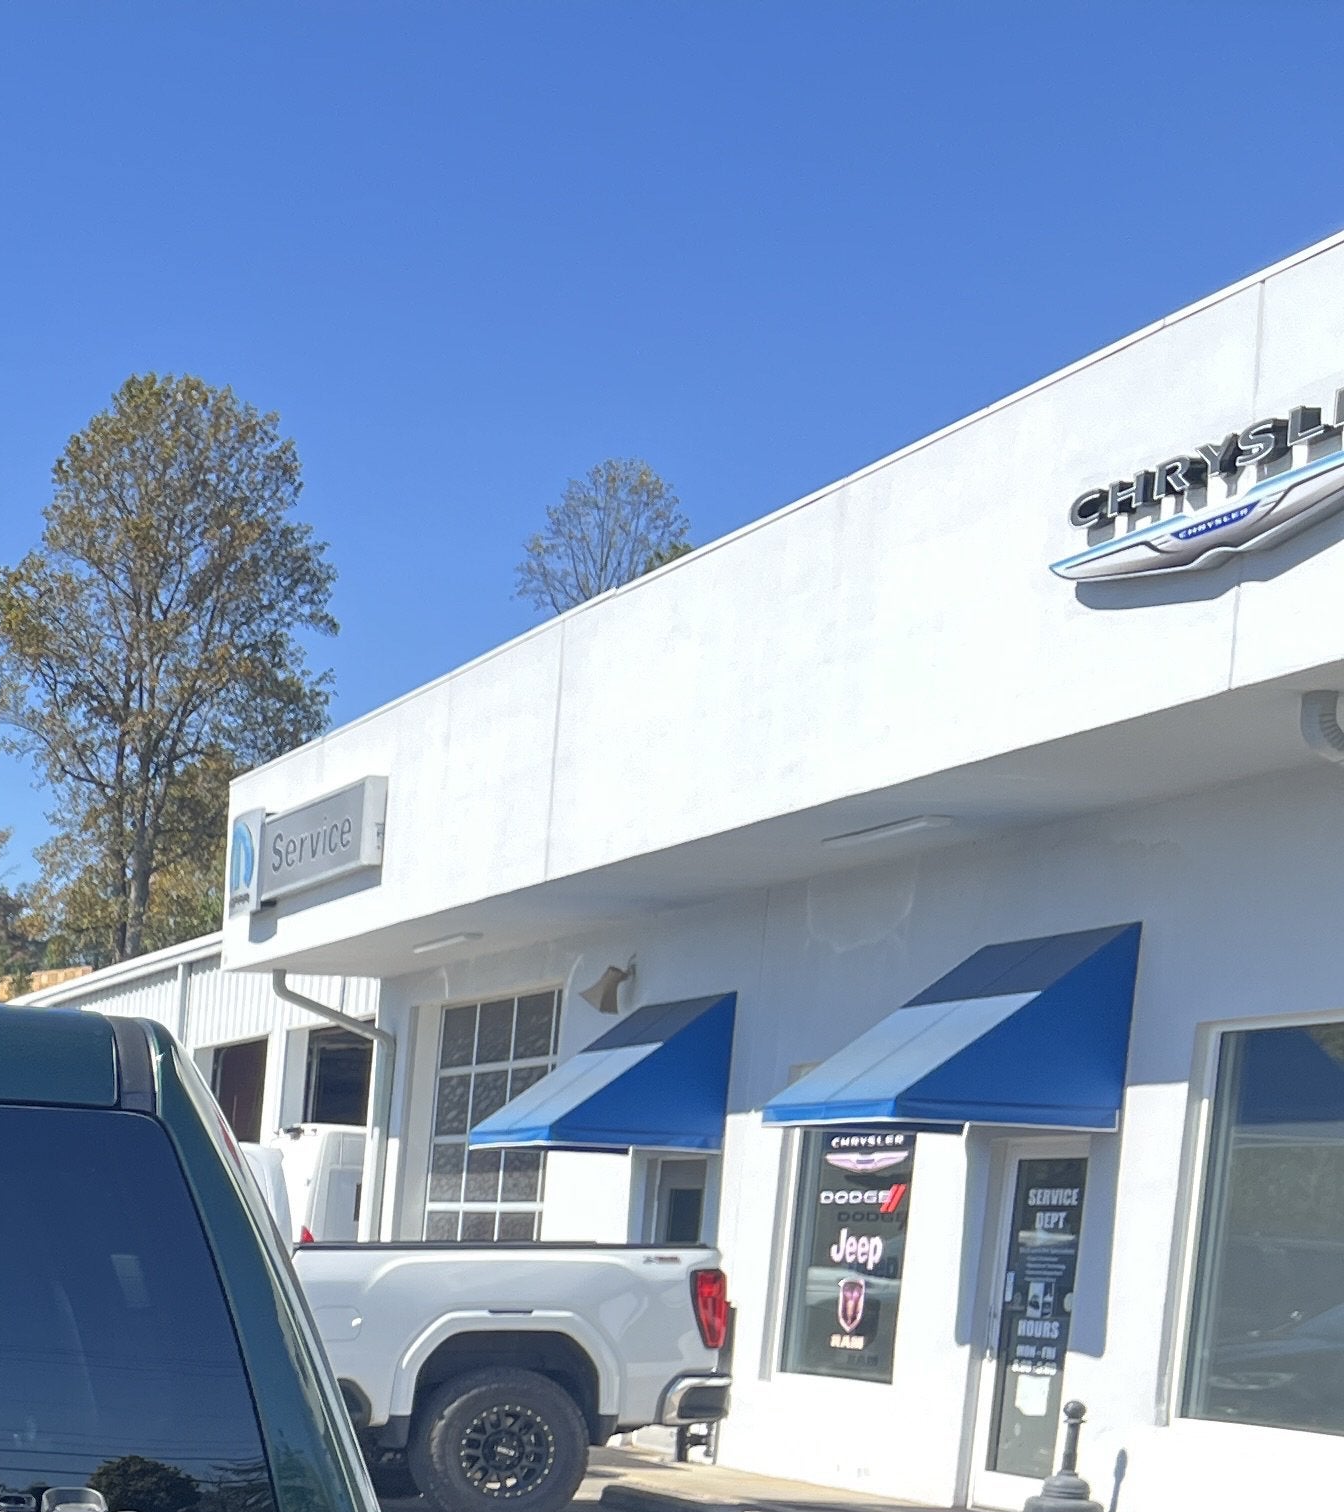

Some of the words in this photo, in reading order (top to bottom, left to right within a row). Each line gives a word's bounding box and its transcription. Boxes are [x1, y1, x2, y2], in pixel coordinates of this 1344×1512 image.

[1068, 385, 1344, 531] CHRYSL
[1178, 507, 1248, 539] CHRYSLER
[271, 816, 352, 873] Service
[831, 1134, 904, 1149] CHRYSLER
[820, 1190, 891, 1205] DODGE
[1028, 1187, 1080, 1207] SERVICE
[1035, 1211, 1067, 1229] DEPT
[830, 1227, 883, 1271] Jeep
[1017, 1319, 1060, 1339] HOURS
[830, 1333, 864, 1350] RAM
